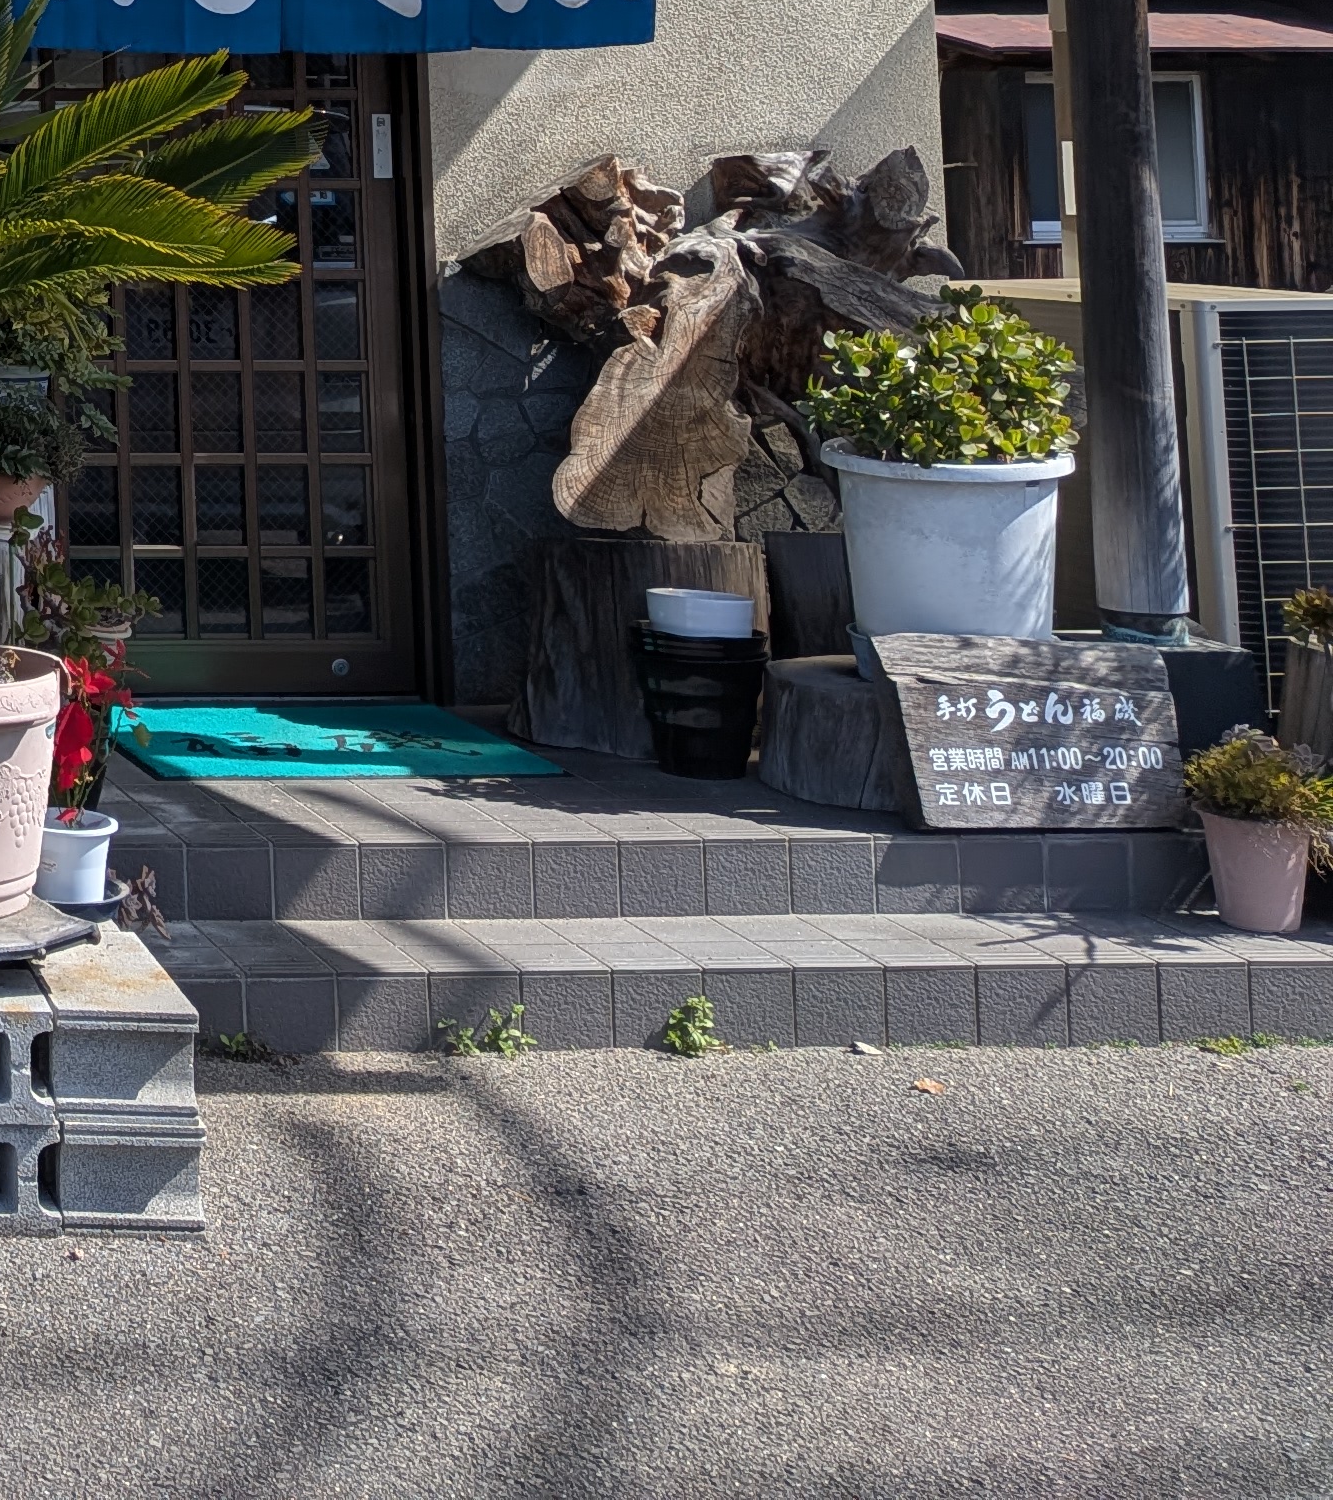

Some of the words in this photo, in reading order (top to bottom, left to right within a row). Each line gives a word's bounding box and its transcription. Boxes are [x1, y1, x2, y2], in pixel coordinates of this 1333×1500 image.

[928, 746, 1005, 771] 営業時間
[935, 782, 1012, 806] 定休日
[1054, 781, 1132, 805] 水曜日
